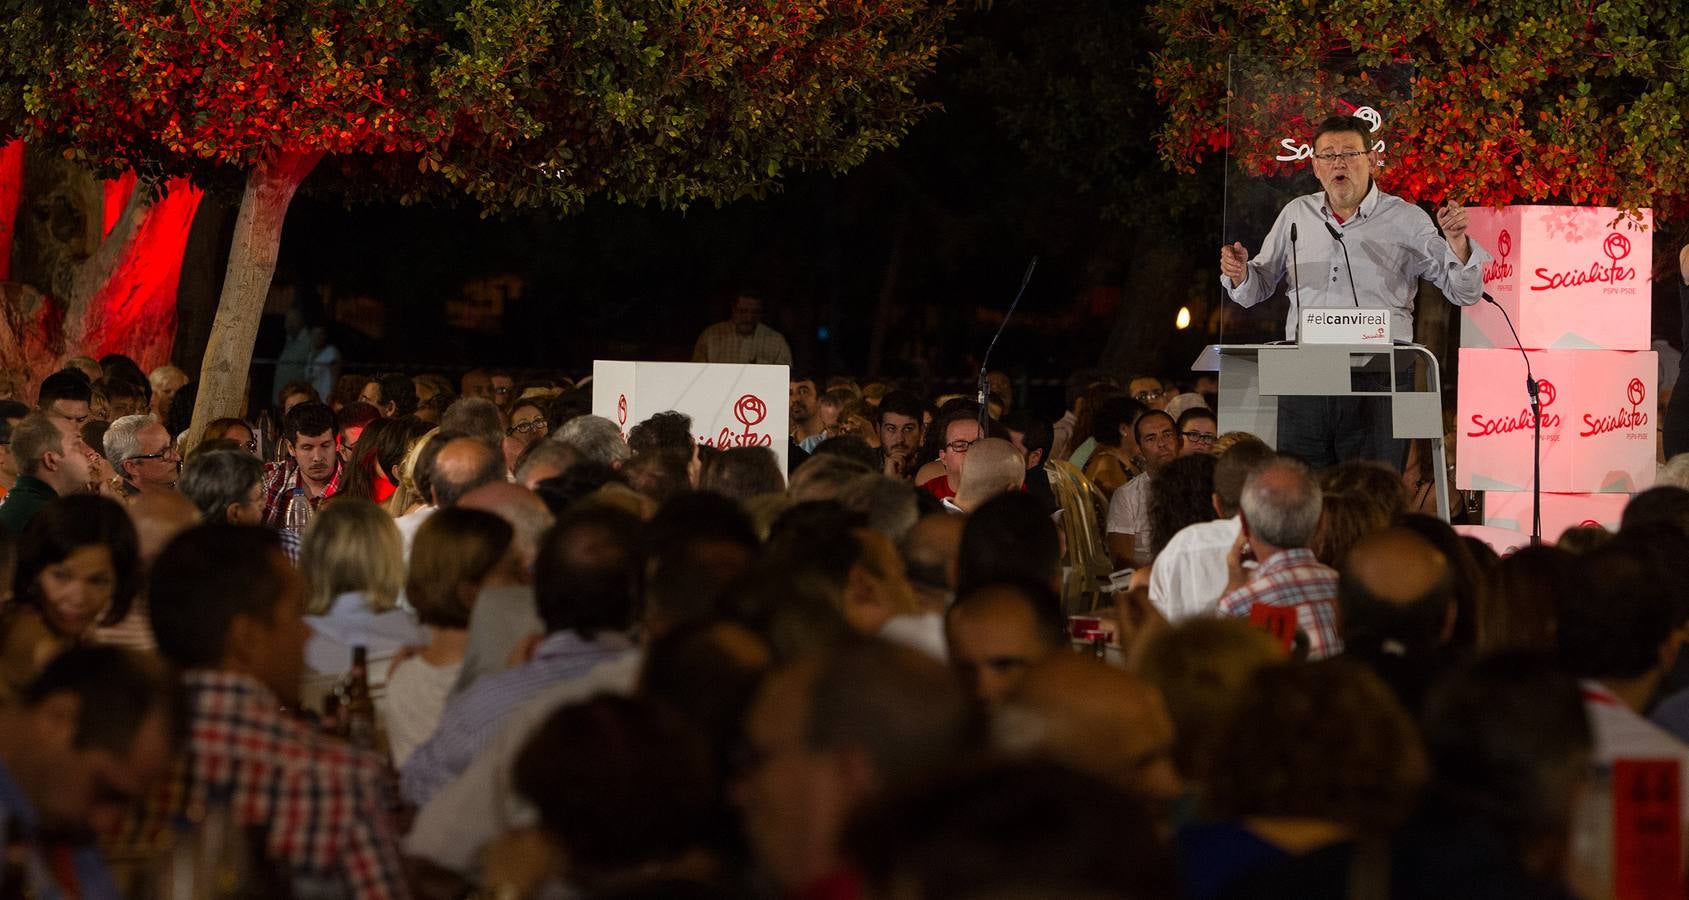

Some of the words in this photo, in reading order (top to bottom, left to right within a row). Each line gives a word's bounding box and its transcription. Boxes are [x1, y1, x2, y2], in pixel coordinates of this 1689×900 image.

[1483, 259, 1512, 284] ialistes
[1530, 259, 1635, 291] Socialistes
[1307, 312, 1386, 325] #elcanvireal
[1580, 406, 1648, 437] Socialistes
